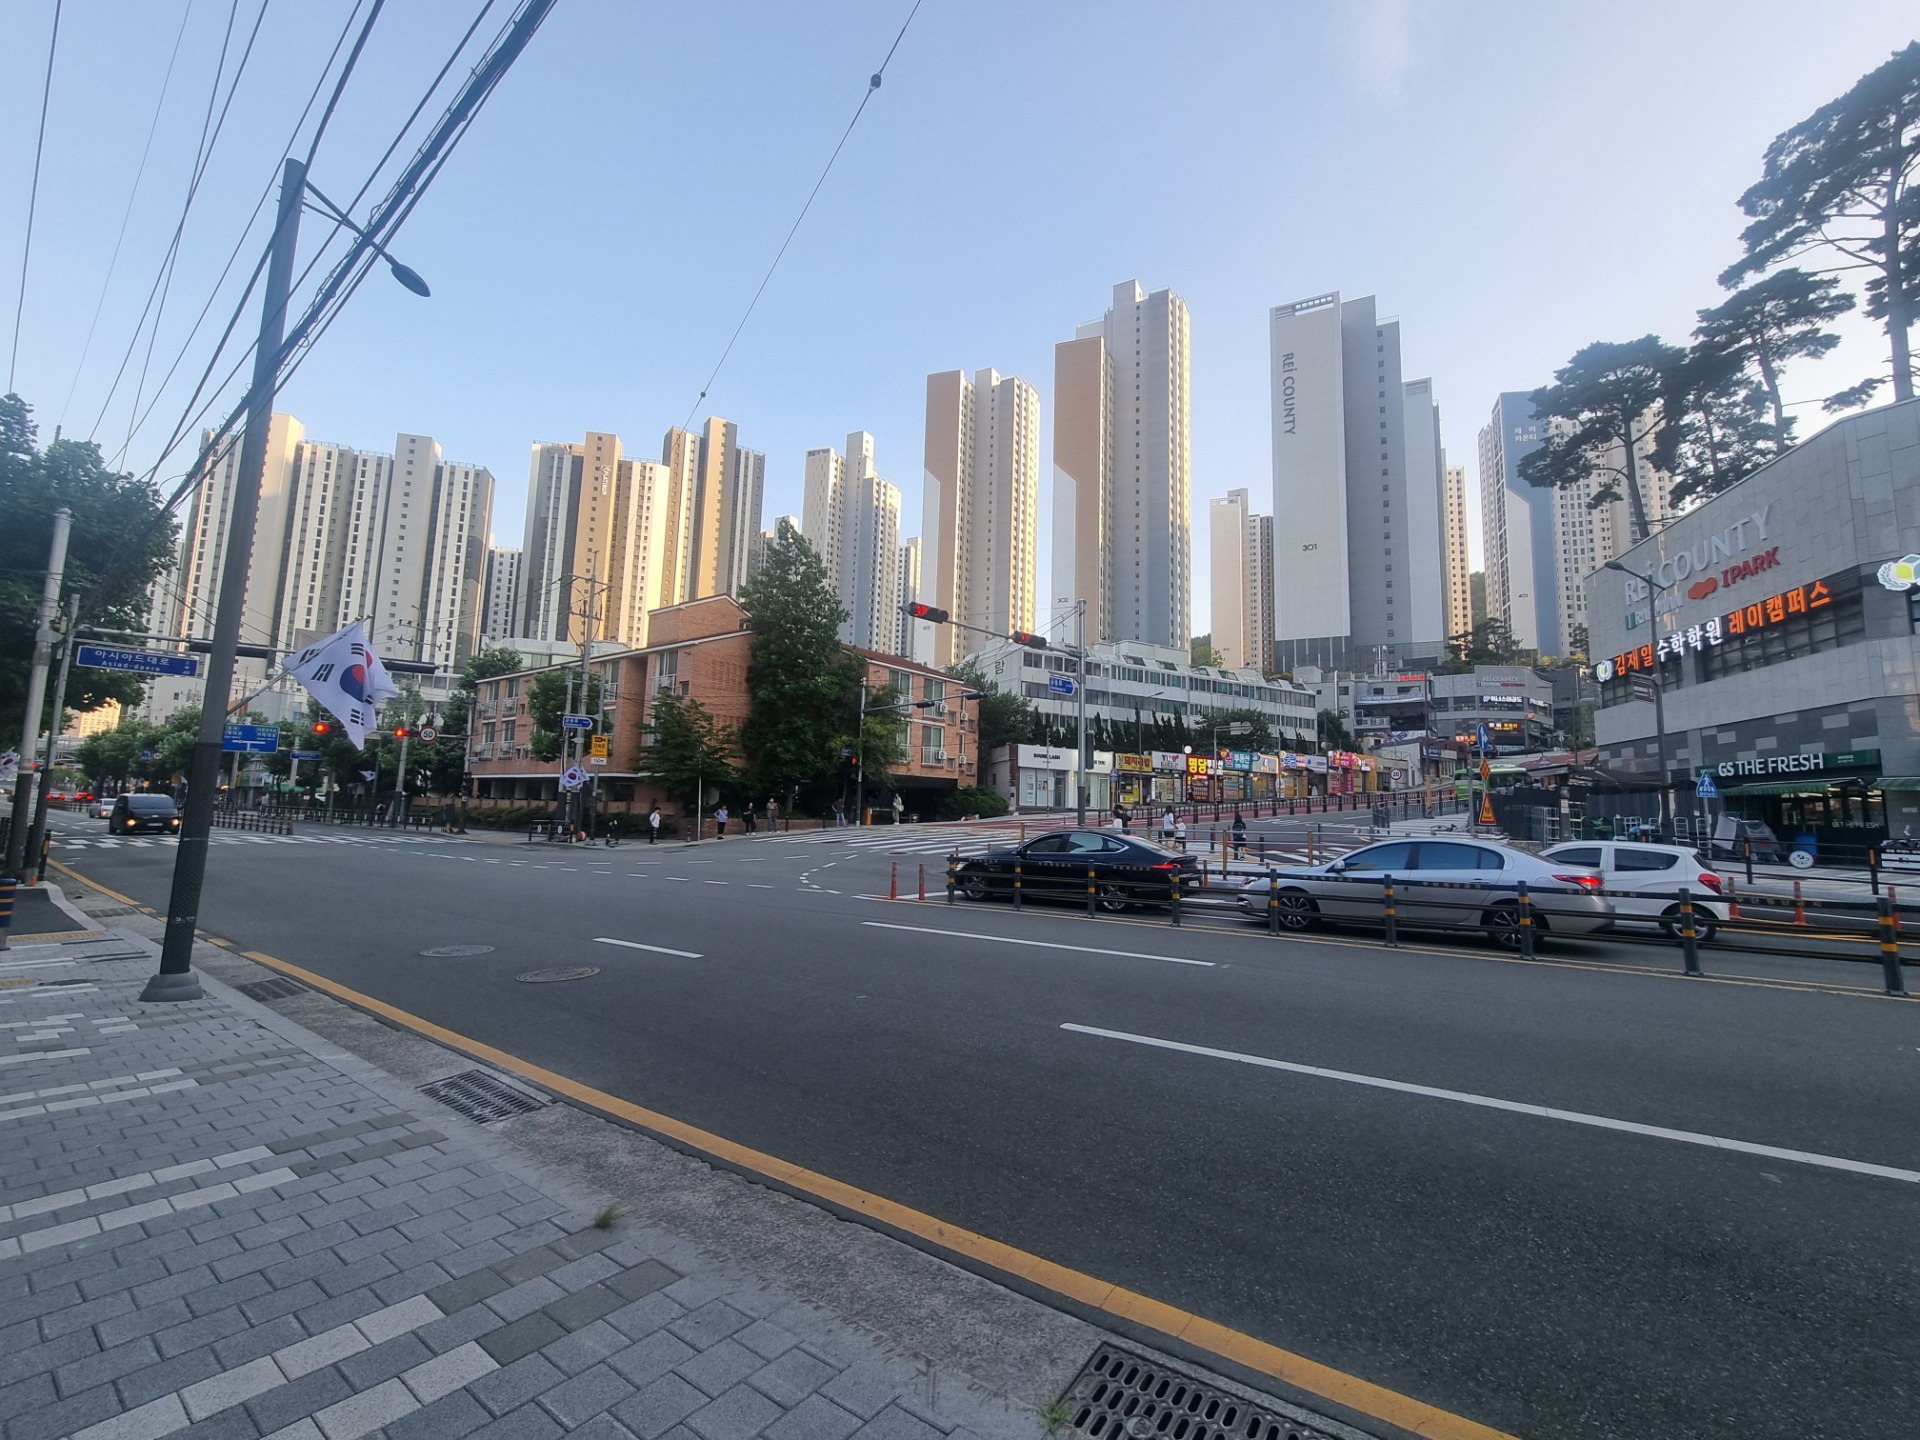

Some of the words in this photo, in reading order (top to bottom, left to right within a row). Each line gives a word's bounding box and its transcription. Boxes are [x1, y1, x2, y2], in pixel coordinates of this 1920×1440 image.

[1283, 376, 1296, 435] COUNTY
[1302, 543, 1318, 552] 301
[1658, 504, 1772, 589] COUNTY
[1720, 546, 1781, 589] IPARK
[1656, 616, 1723, 662] 수학학원
[1728, 579, 1832, 635] 레이캠퍼스
[94, 649, 171, 666] 아시아드대로
[1188, 757, 1207, 774] 명당
[1233, 753, 1251, 764] 부동산
[1718, 761, 1735, 777] GS
[1735, 758, 1766, 775] THE
[1767, 752, 1824, 773] FRESH
